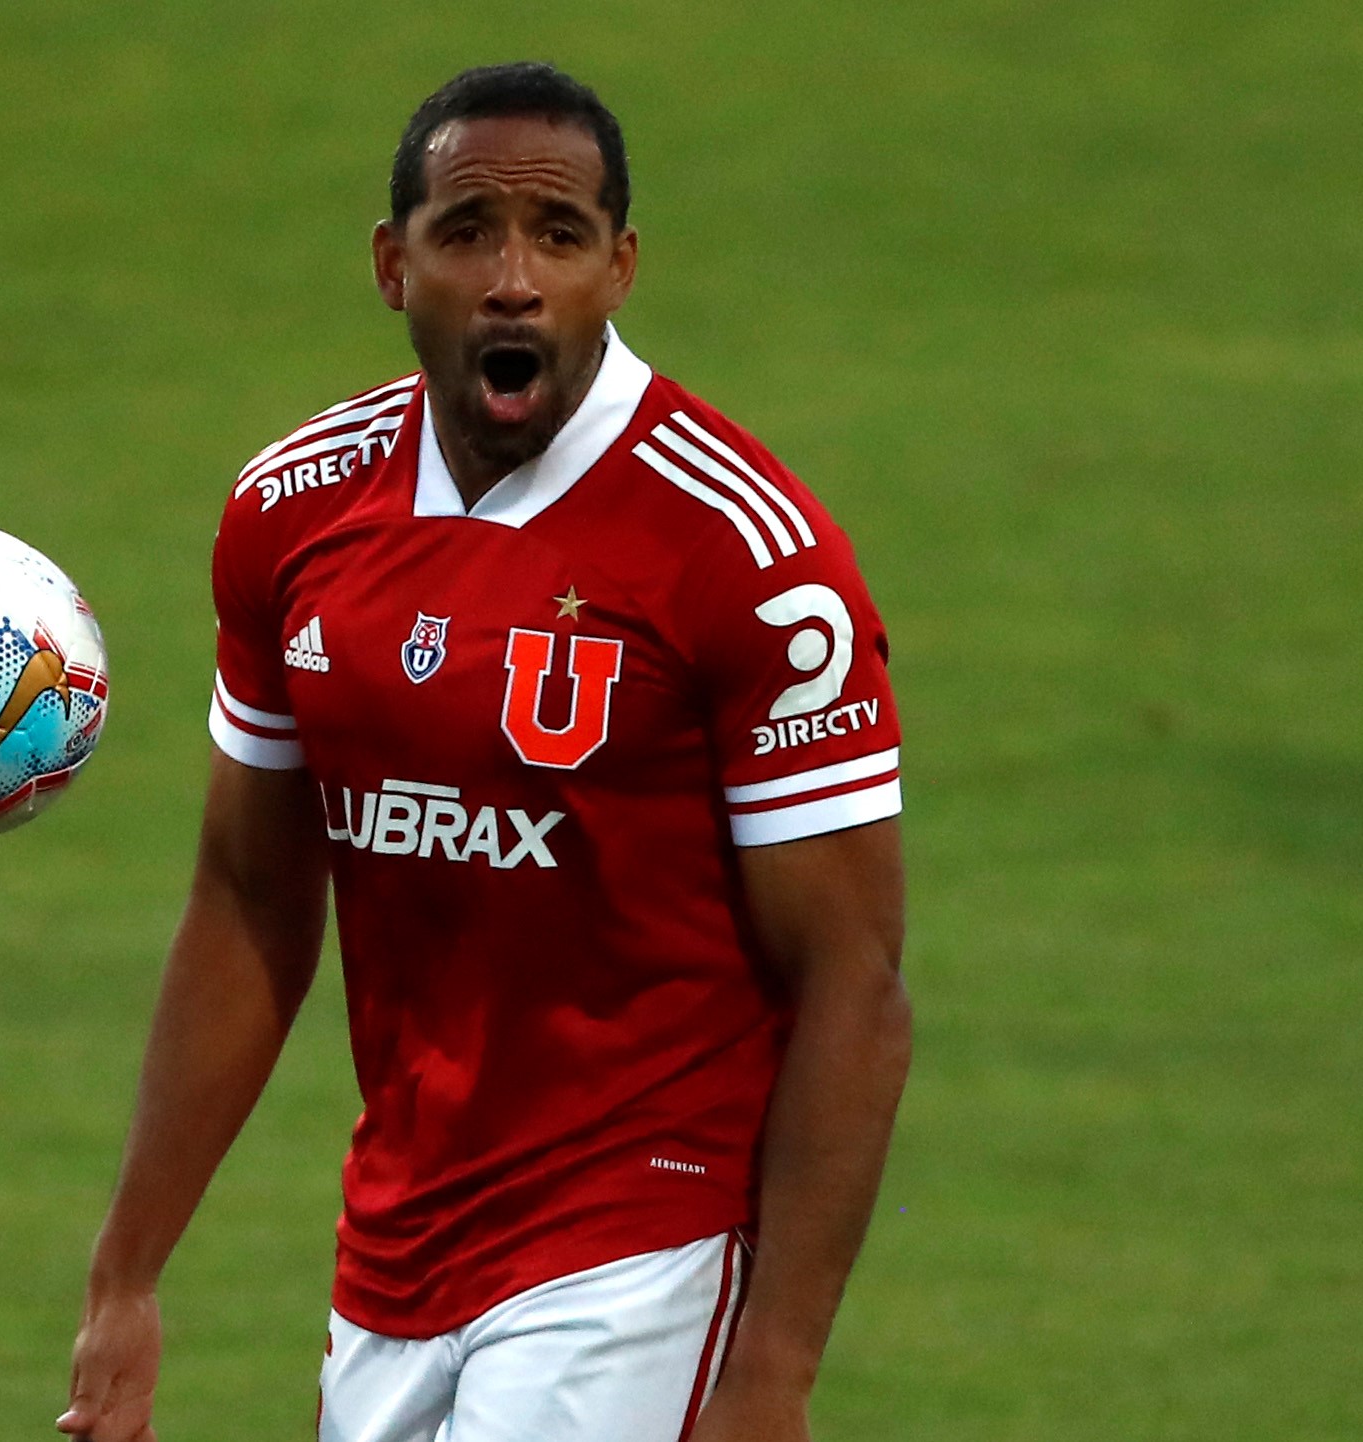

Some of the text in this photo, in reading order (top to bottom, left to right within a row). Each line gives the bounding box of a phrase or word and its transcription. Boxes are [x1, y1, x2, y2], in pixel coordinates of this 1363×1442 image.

[256, 428, 401, 512] DIRECTV
[284, 648, 330, 673] adidas
[412, 648, 435, 672] U
[500, 626, 624, 770] U
[751, 698, 878, 755] DIRECTV
[320, 779, 566, 869] LUBRAX
[650, 1157, 706, 1175] AEROREADY
